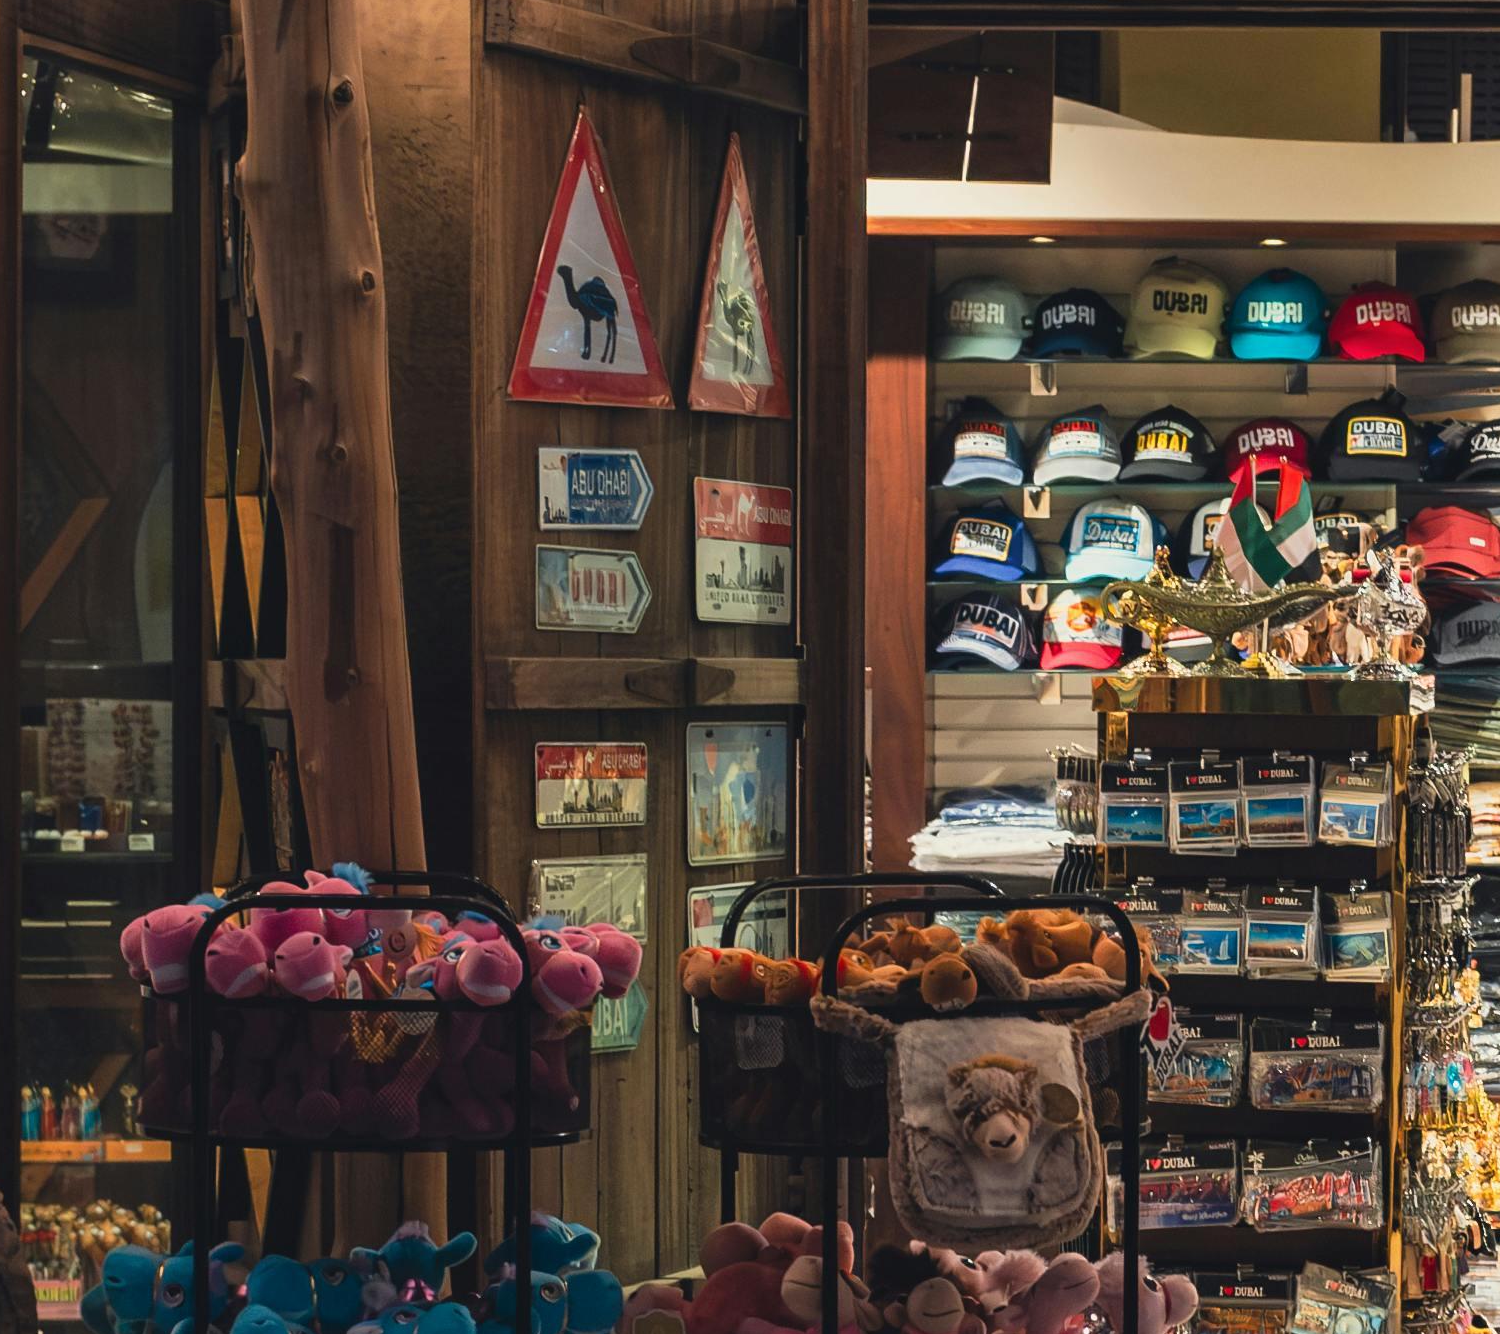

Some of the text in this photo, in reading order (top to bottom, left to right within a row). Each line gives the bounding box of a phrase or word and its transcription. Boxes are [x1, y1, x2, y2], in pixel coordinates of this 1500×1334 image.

[1153, 290, 1208, 316] DUBAI
[1248, 301, 1303, 326] DUBAI
[1356, 301, 1412, 326] DUBAI
[1042, 304, 1096, 329] DUBAI
[1052, 419, 1097, 435] DUBAI
[1353, 422, 1401, 435] DUBAI
[1136, 432, 1188, 454] DUBAI
[1238, 427, 1295, 454] DUBAI
[571, 468, 631, 496] ABU DHABI
[958, 521, 1008, 541] DUBAI
[1085, 520, 1137, 545] Dubai
[957, 605, 1019, 640] DUBAI
[1129, 778, 1153, 787] DUBAI
[1198, 775, 1222, 785] DUBAI
[1271, 769, 1295, 779] DUBAI
[1274, 896, 1299, 906] DUBAI
[592, 995, 628, 1037] UBAI
[1308, 1035, 1340, 1048] DUBAI
[1164, 1156, 1195, 1169] DUBAI
[1235, 1286, 1263, 1297] DUBAI
